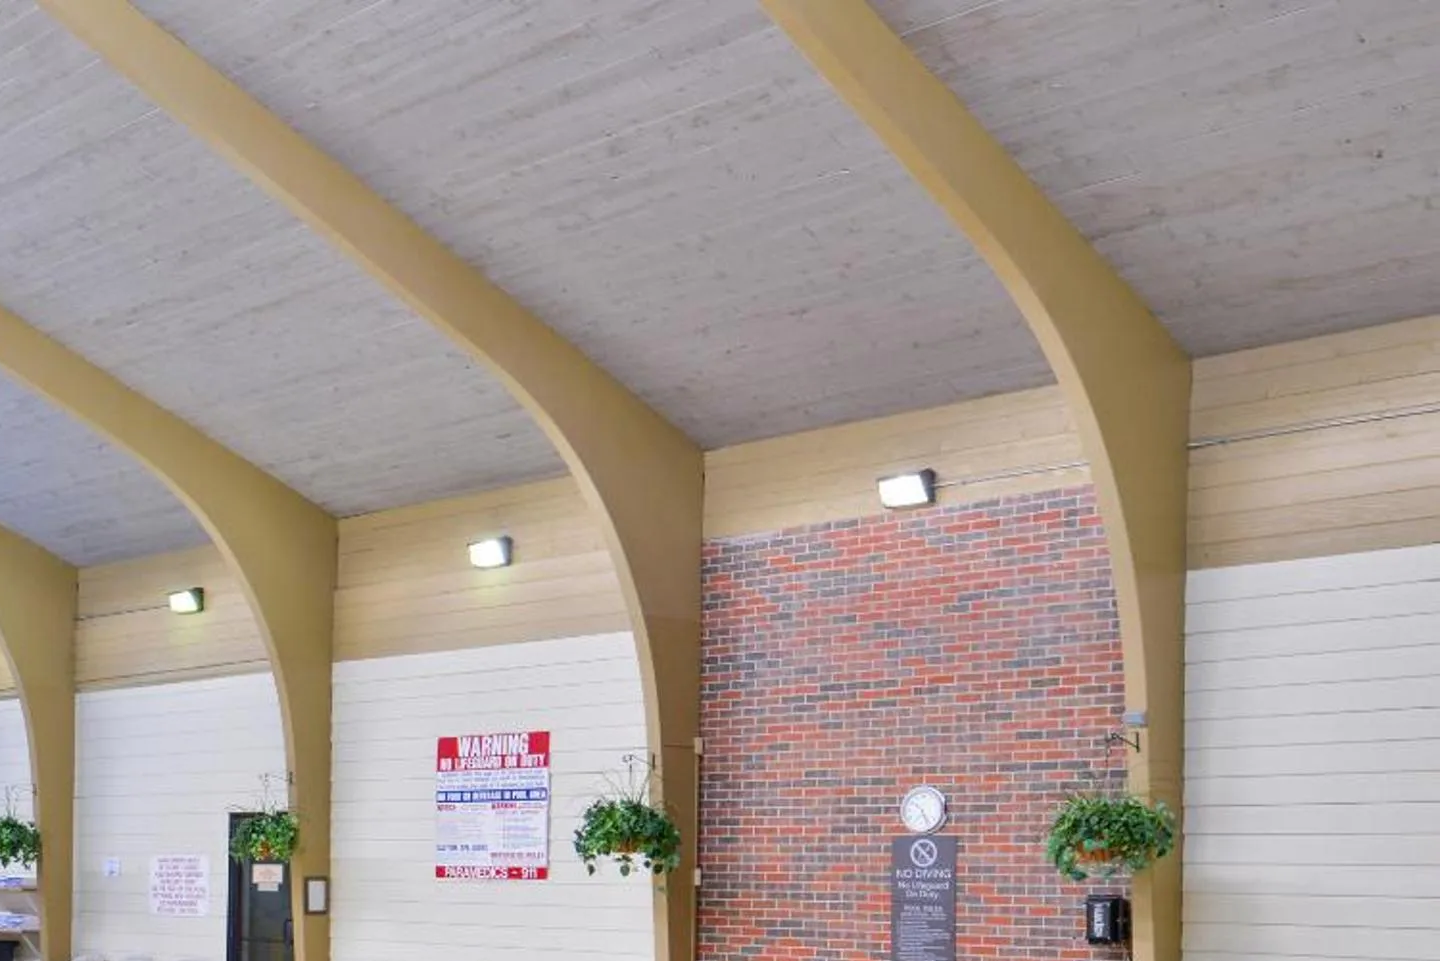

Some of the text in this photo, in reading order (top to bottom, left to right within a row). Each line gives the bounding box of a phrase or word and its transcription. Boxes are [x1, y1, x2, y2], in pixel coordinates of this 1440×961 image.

[458, 732, 529, 757] WARNING
[440, 753, 546, 770] NO LIFEGUARD ON DUTY
[445, 866, 508, 879] PARAMEDICS
[895, 869, 952, 879] NO DIVING
